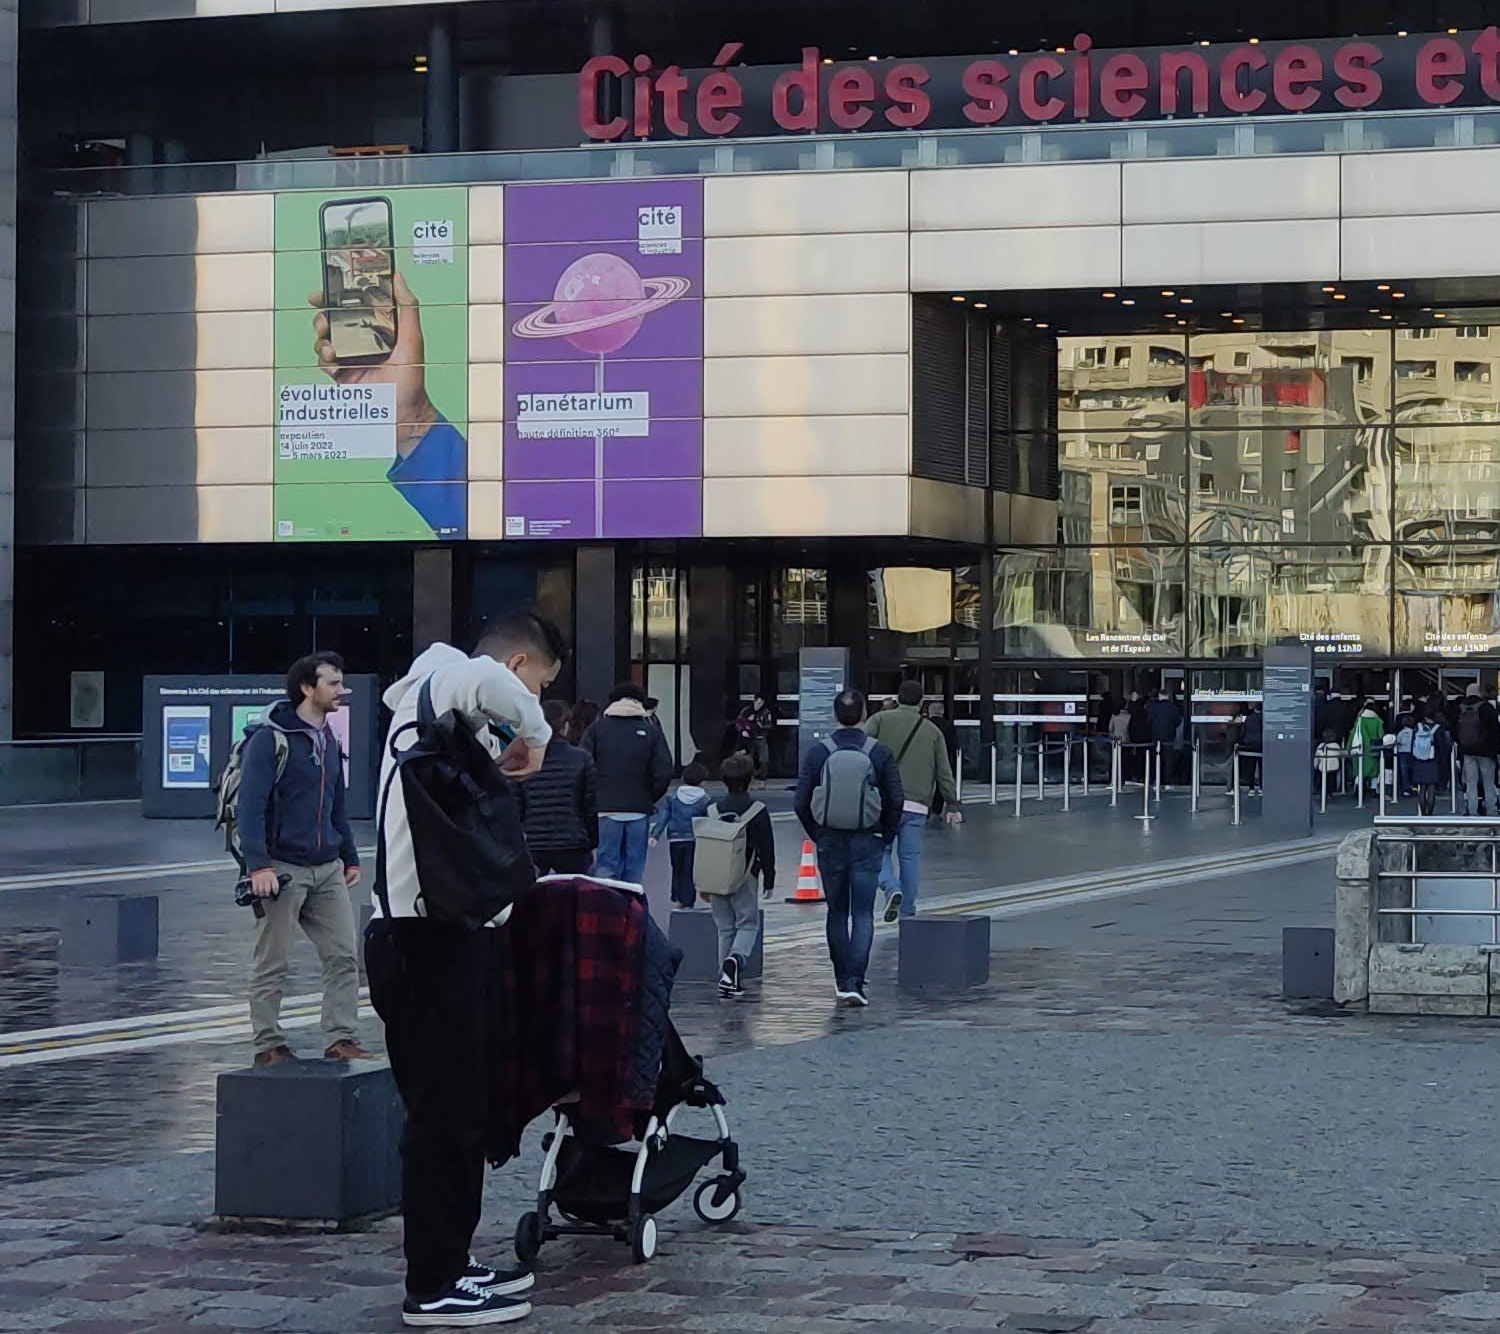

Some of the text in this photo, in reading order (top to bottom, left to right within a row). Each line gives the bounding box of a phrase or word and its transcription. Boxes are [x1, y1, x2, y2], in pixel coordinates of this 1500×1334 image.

[579, 42, 743, 139] Cité
[772, 47, 931, 131] des
[962, 32, 1383, 124] sciences
[640, 206, 676, 226] cité
[413, 219, 448, 239] cité
[280, 384, 373, 401] évolutions
[280, 403, 389, 420] industrielles
[518, 393, 632, 416] planétarium
[547, 427, 594, 437] définition
[291, 441, 309, 452] juin
[310, 441, 333, 450] 2022
